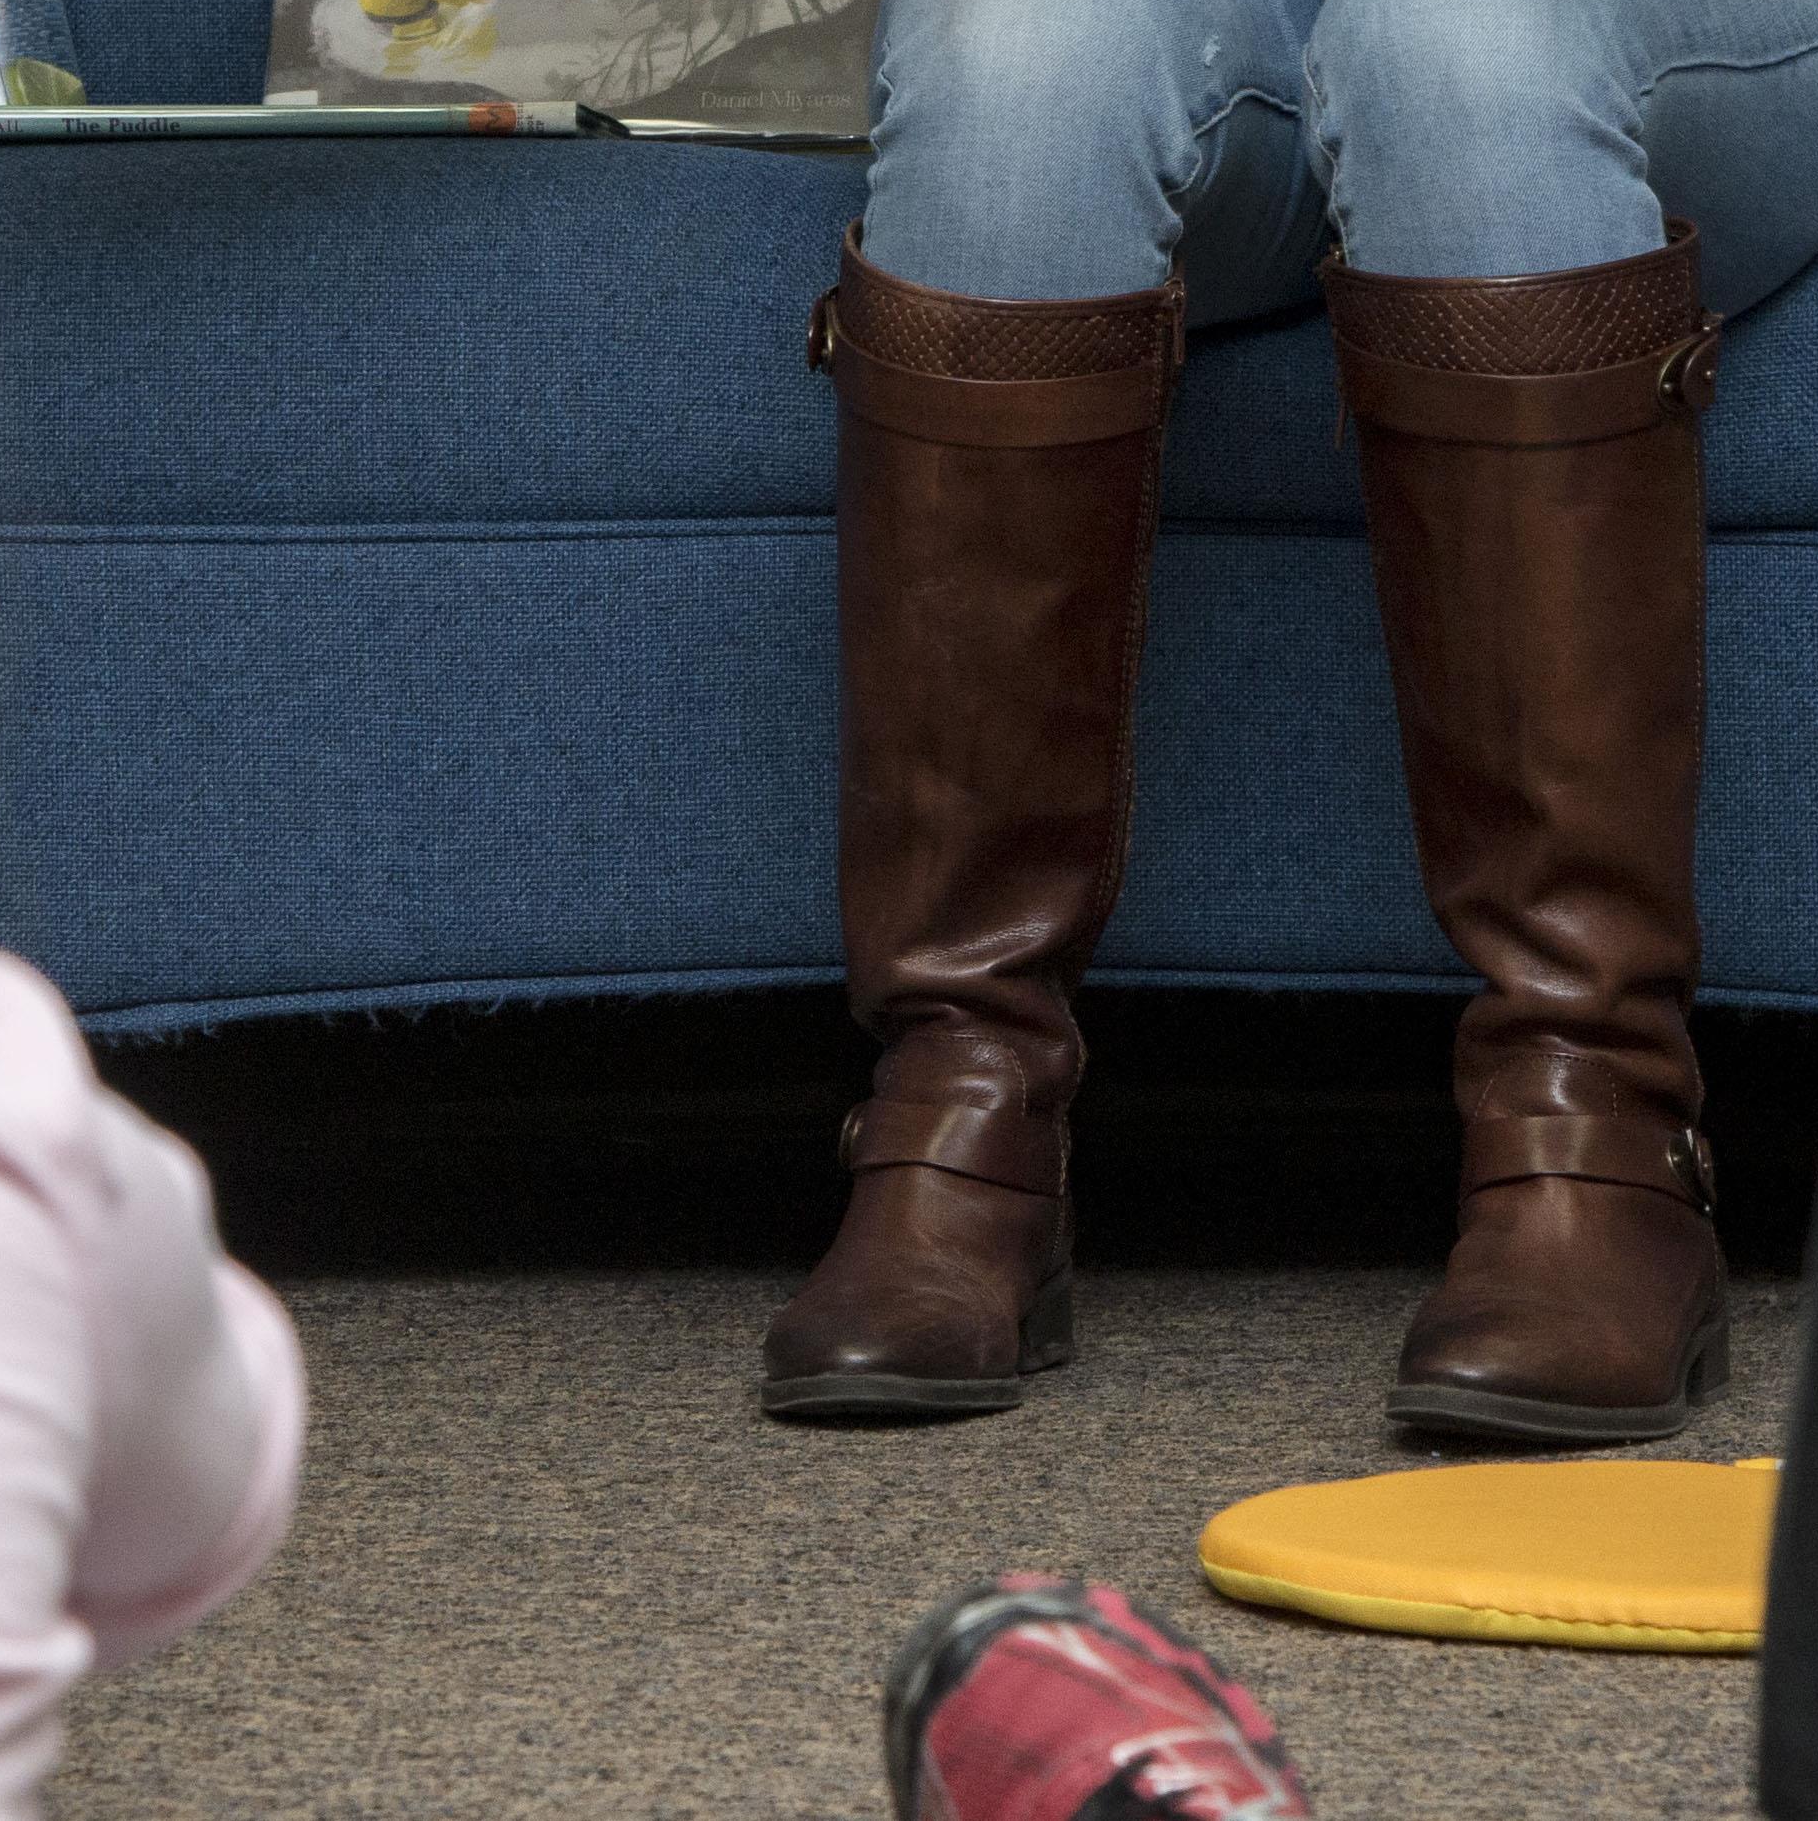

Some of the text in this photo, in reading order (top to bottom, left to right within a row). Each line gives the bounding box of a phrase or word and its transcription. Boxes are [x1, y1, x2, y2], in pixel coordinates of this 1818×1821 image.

[700, 89, 764, 108] Daniel
[61, 118, 99, 134] The
[109, 117, 181, 134] Puddle
